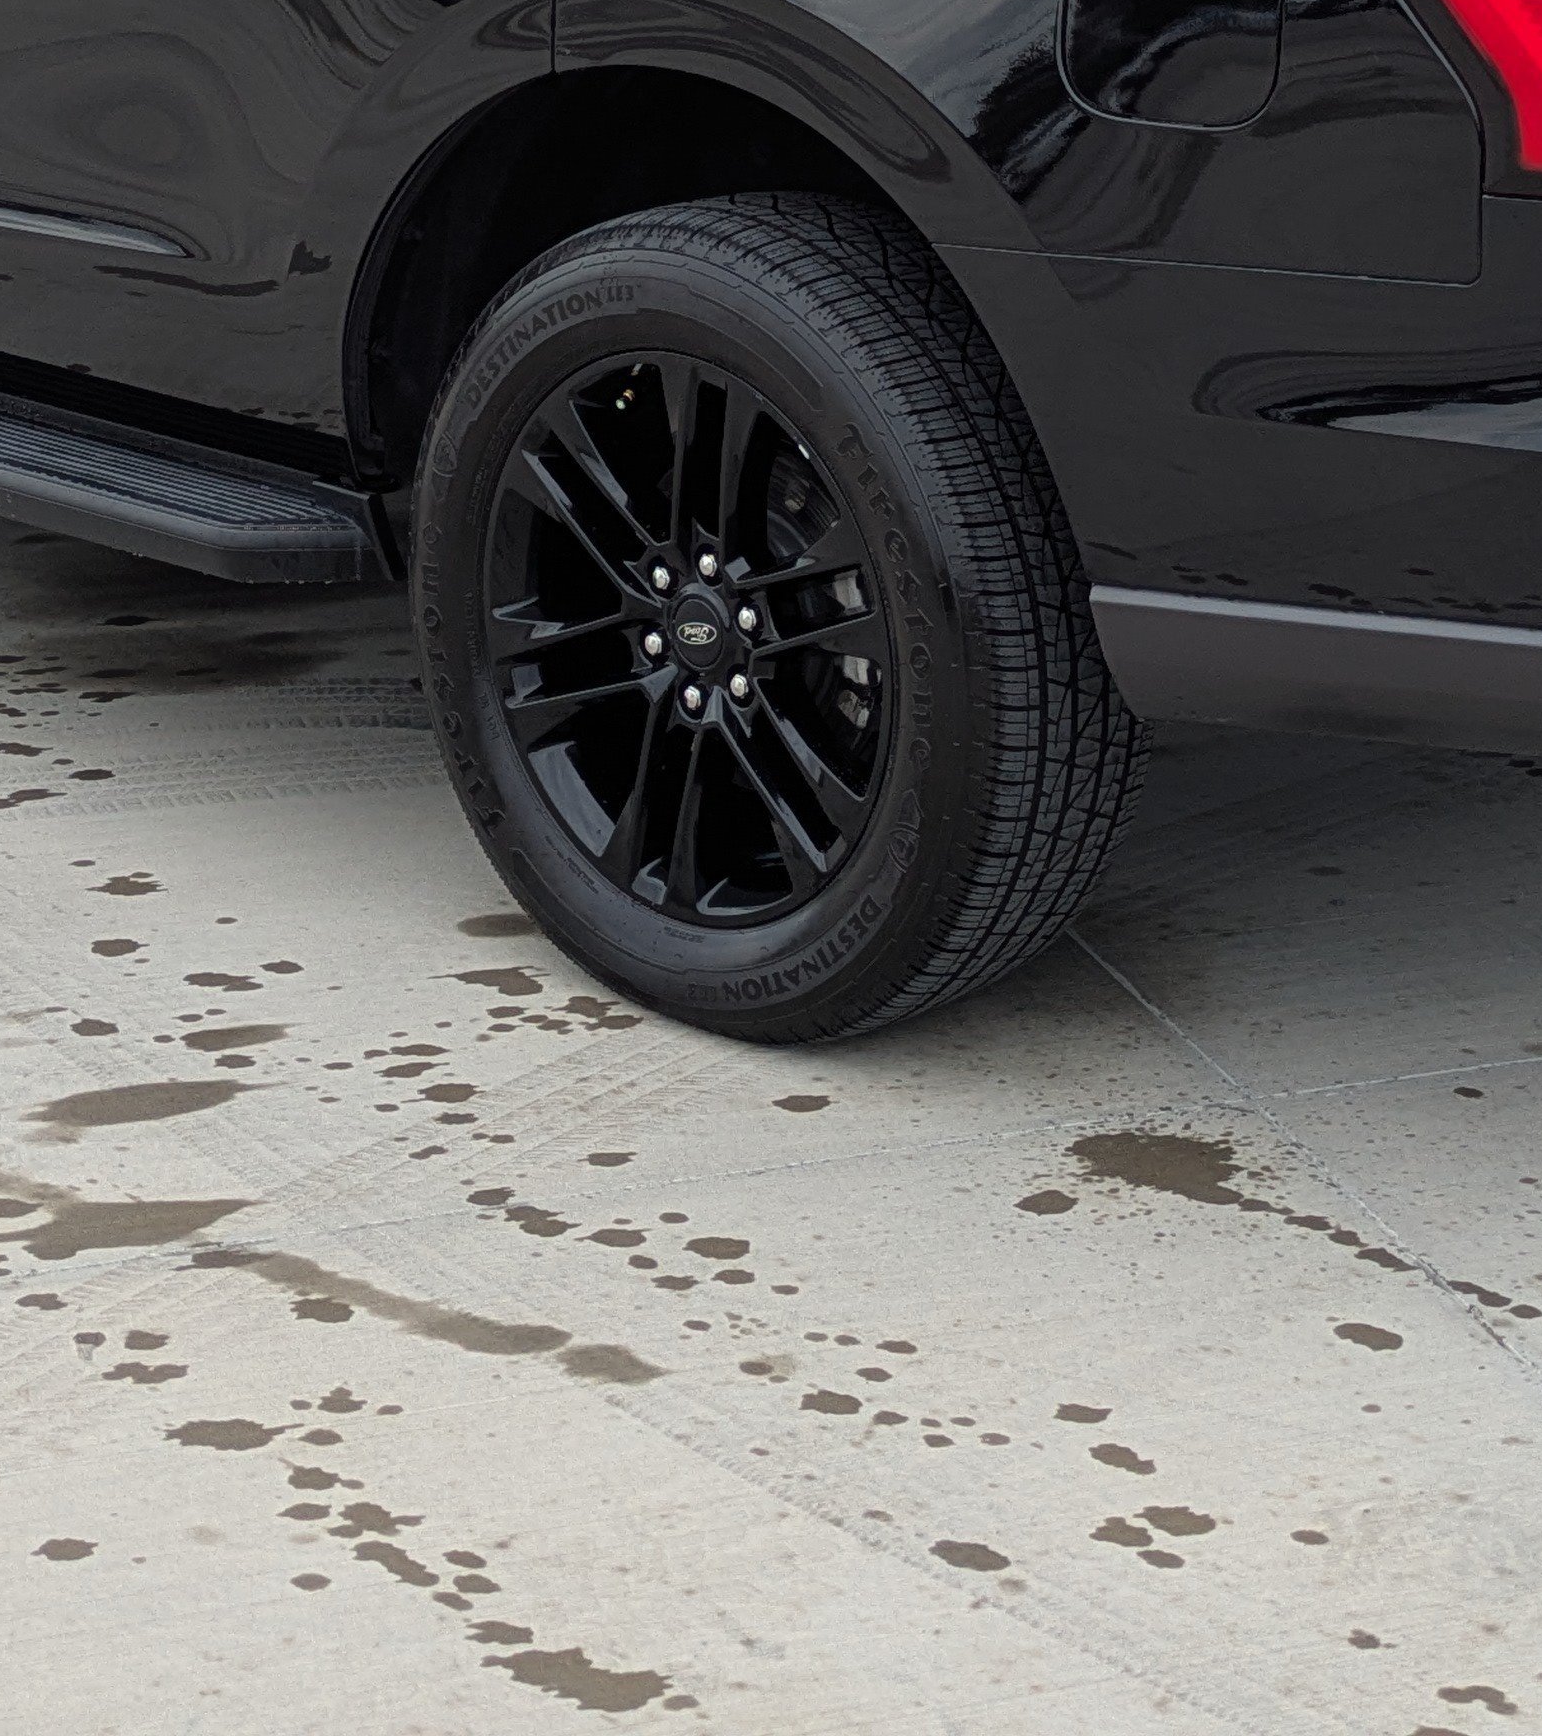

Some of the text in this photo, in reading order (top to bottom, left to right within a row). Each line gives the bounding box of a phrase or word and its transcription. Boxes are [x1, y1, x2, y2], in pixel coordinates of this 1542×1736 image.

[466, 285, 605, 410] DESTINATION
[683, 626, 710, 642] Ford
[722, 895, 883, 1002] DESTINATION
